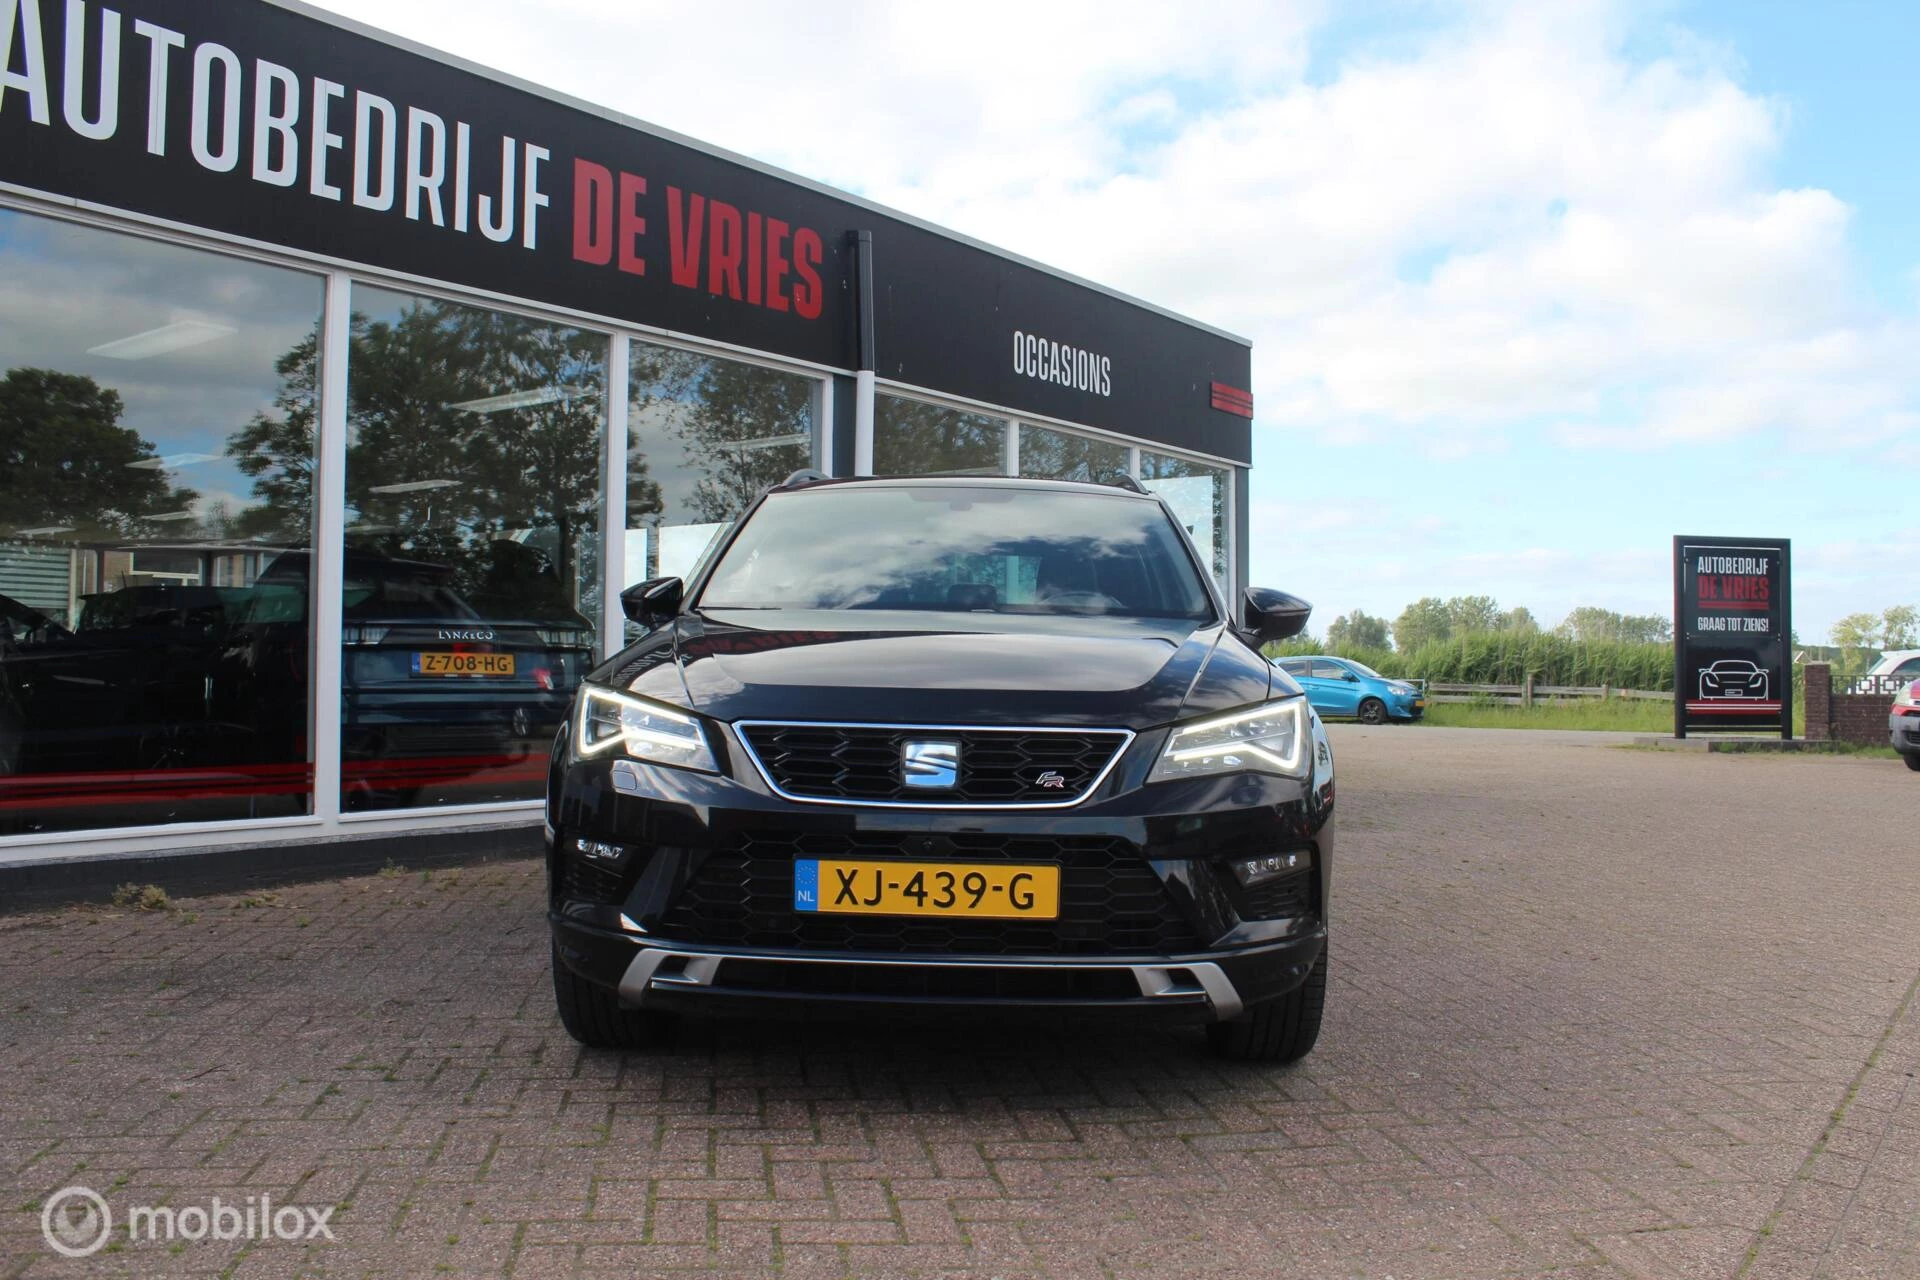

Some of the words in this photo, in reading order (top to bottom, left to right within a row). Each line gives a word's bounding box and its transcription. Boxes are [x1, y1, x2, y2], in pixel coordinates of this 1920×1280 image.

[0, 0, 550, 250] AUTOBEDRIJF
[573, 157, 647, 277] DE
[667, 187, 824, 320] VRIES
[1013, 330, 1111, 397] OCCASIONS
[1697, 557, 1769, 574] AUTOBEDRIJF
[1698, 575, 1717, 598] DE
[1722, 576, 1769, 599] VRIES
[1697, 617, 1725, 631] GRAAG
[1727, 618, 1742, 631] TOT
[1744, 618, 1769, 632] ZIENS!
[426, 655, 508, 671] Z-708-HG
[797, 890, 815, 902] NL
[834, 868, 1034, 910] XJ-439-G
